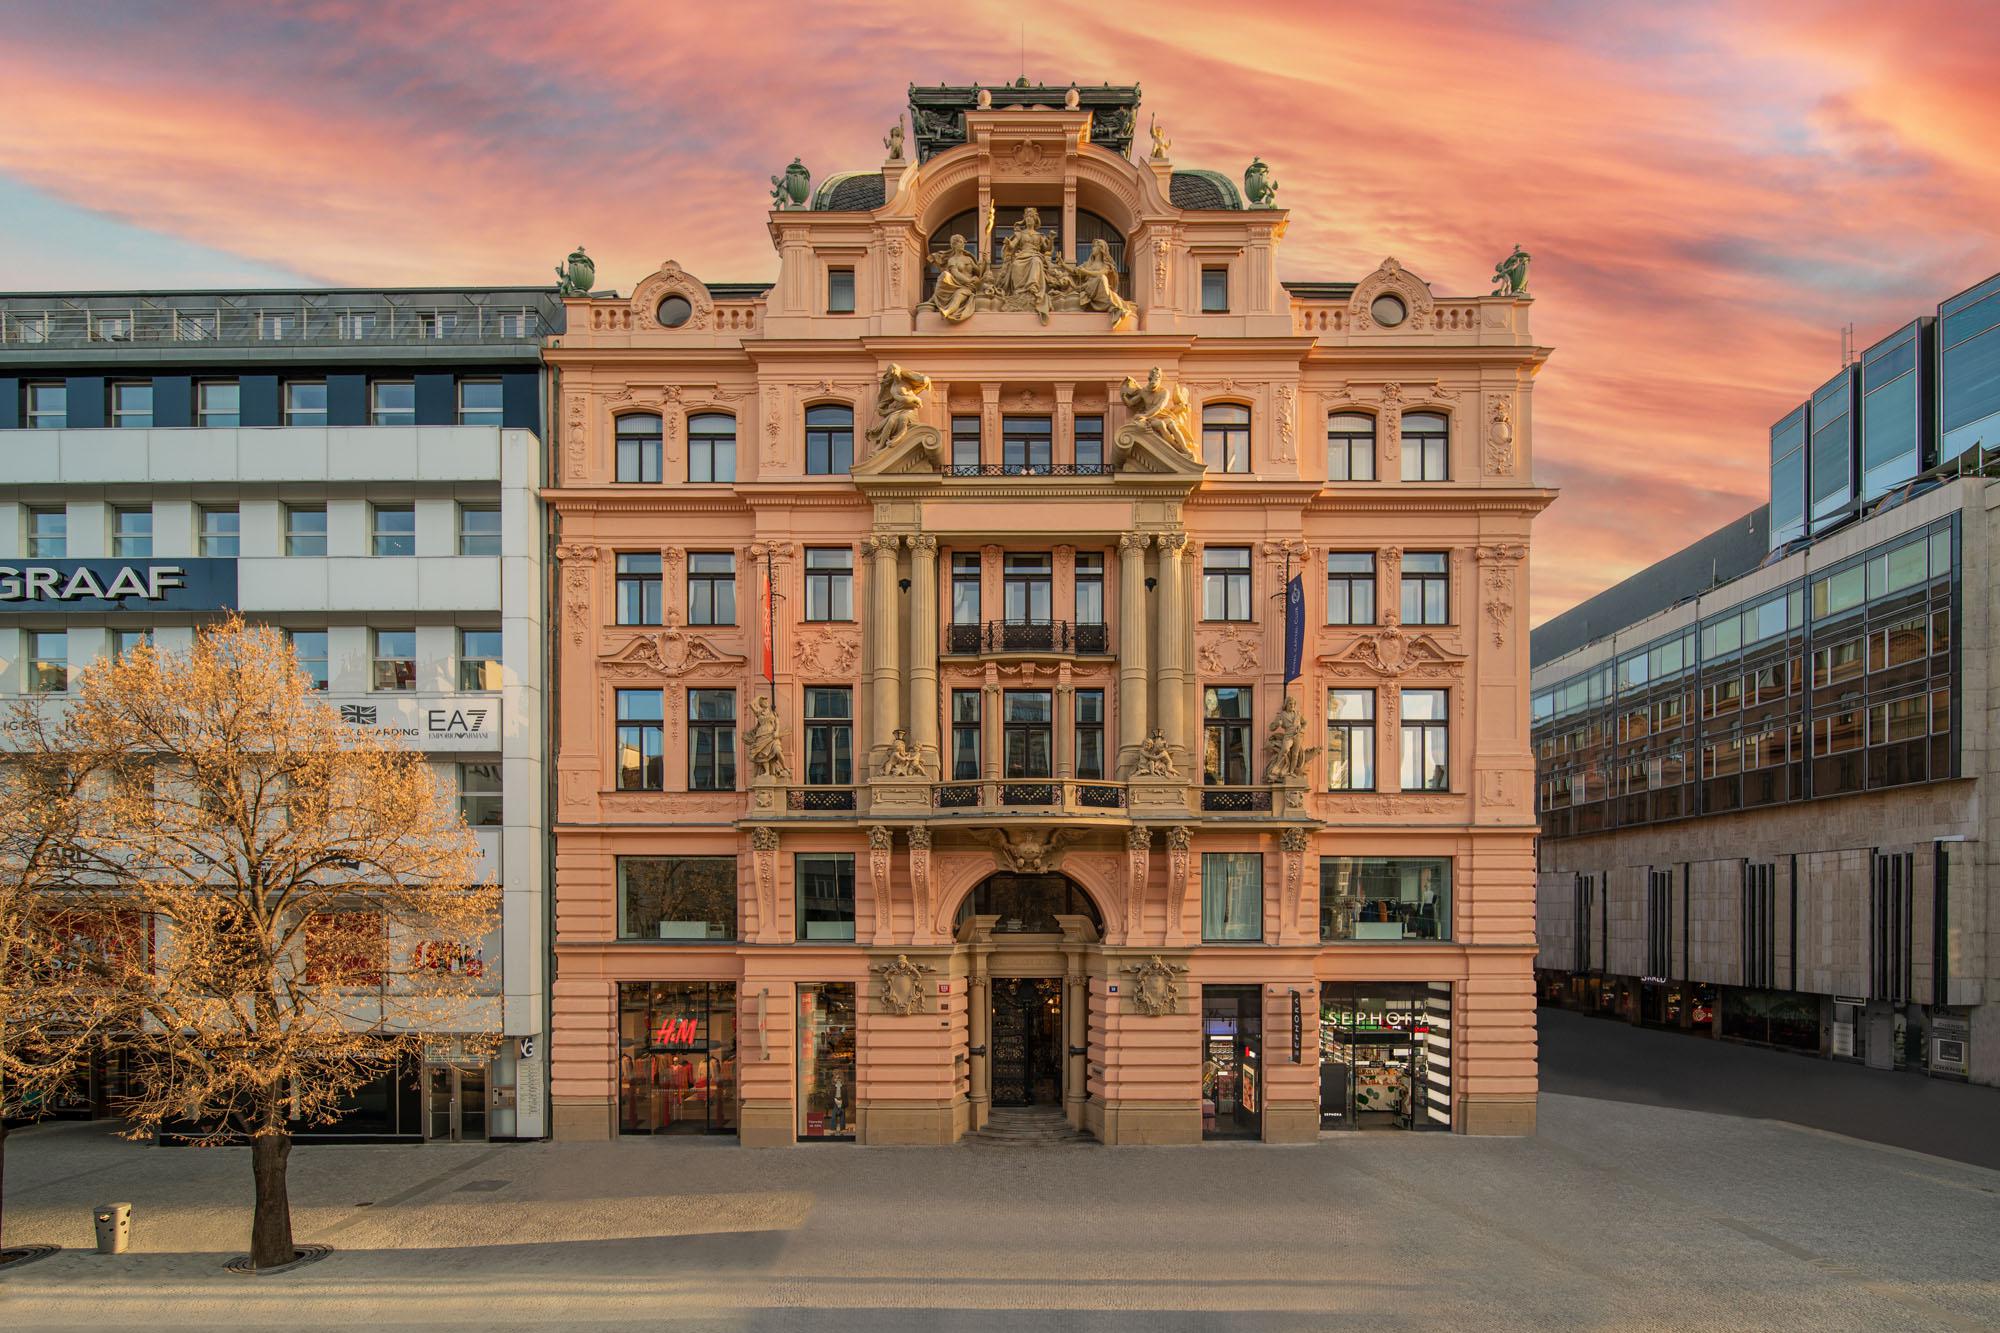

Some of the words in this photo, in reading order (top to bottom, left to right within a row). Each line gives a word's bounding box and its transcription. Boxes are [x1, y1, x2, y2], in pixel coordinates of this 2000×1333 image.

[0, 566, 180, 599] GRAAF
[428, 709, 488, 732] EA7
[1328, 1011, 1431, 1026] SEPHORA
[656, 1018, 698, 1045] H&M
